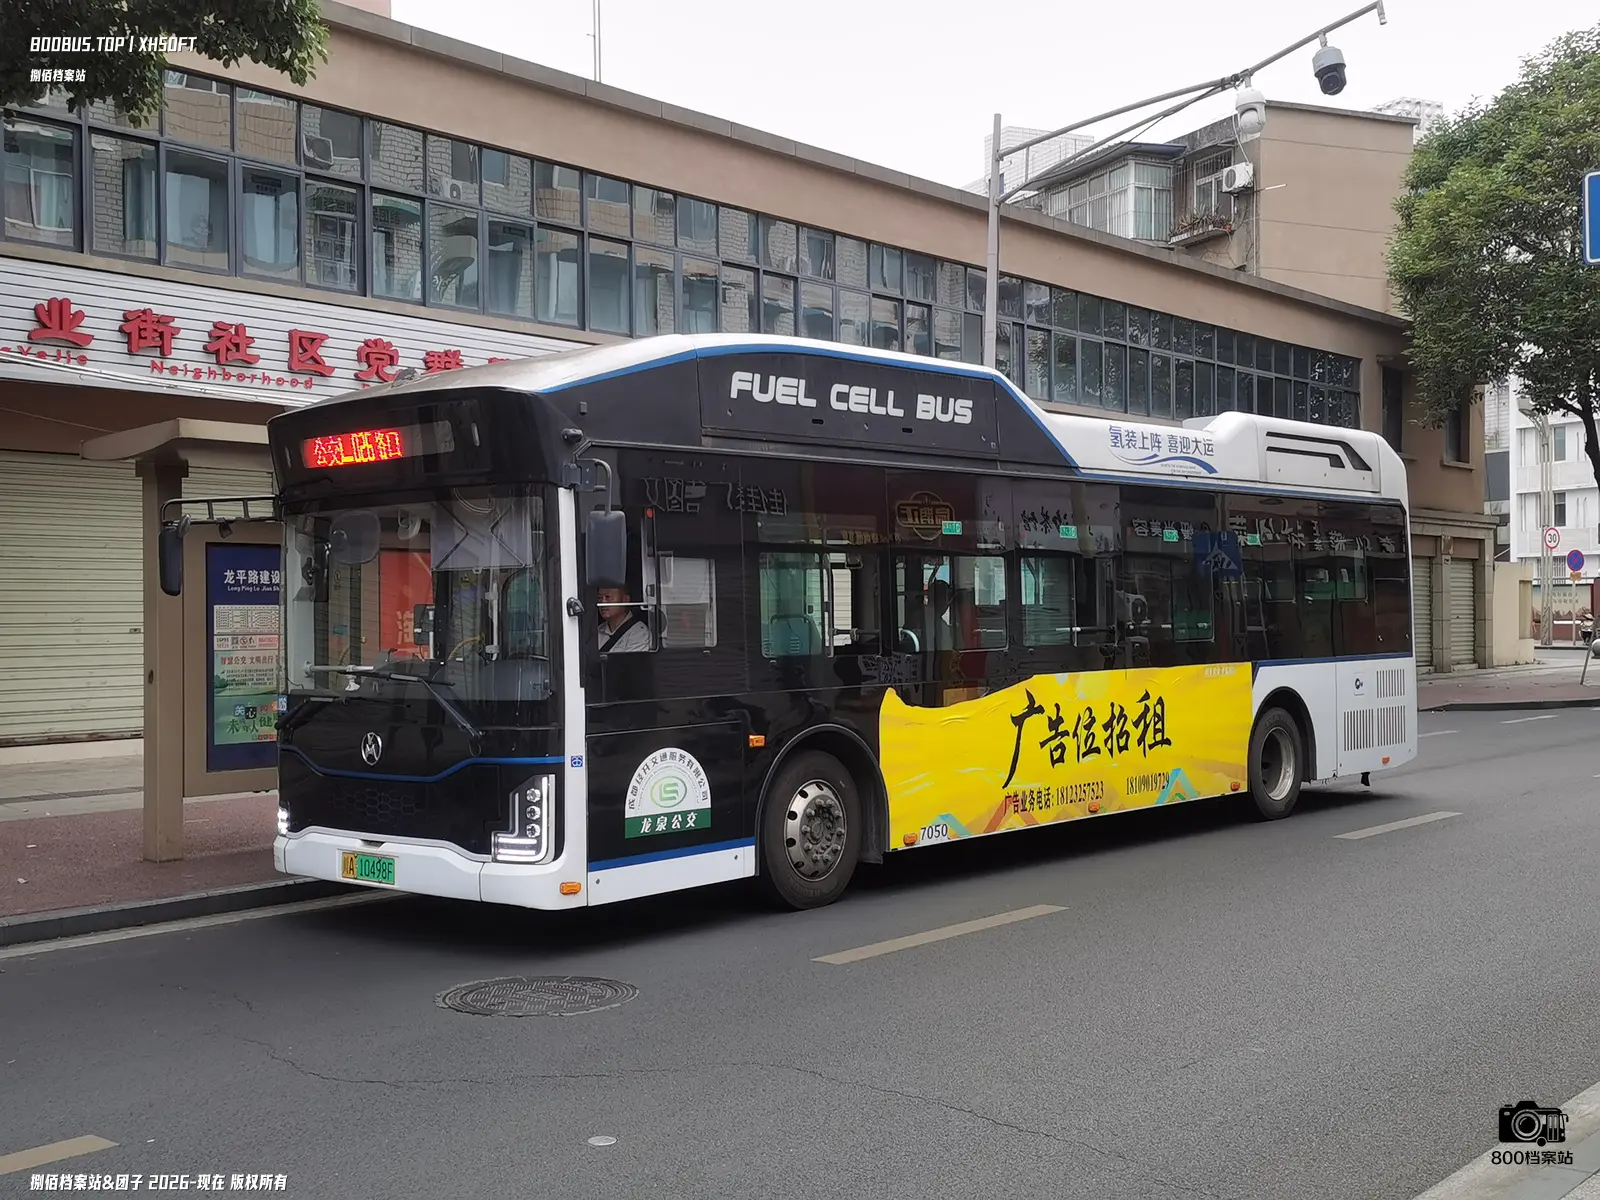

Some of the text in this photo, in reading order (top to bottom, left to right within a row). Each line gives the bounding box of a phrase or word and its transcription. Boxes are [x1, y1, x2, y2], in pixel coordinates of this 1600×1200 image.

[150, 360, 314, 389] Neighborhood
[730, 371, 973, 424] FUEL CELL BUS
[1109, 424, 1215, 457] 氢装上阵 喜迎大运
[1547, 533, 1557, 543] 30
[224, 569, 280, 585] 龙平路建设
[1002, 688, 1172, 790] 广告位招租
[1126, 771, 1170, 795] 18109019729
[640, 811, 698, 834] 龙泉公交
[920, 824, 948, 841] 7050
